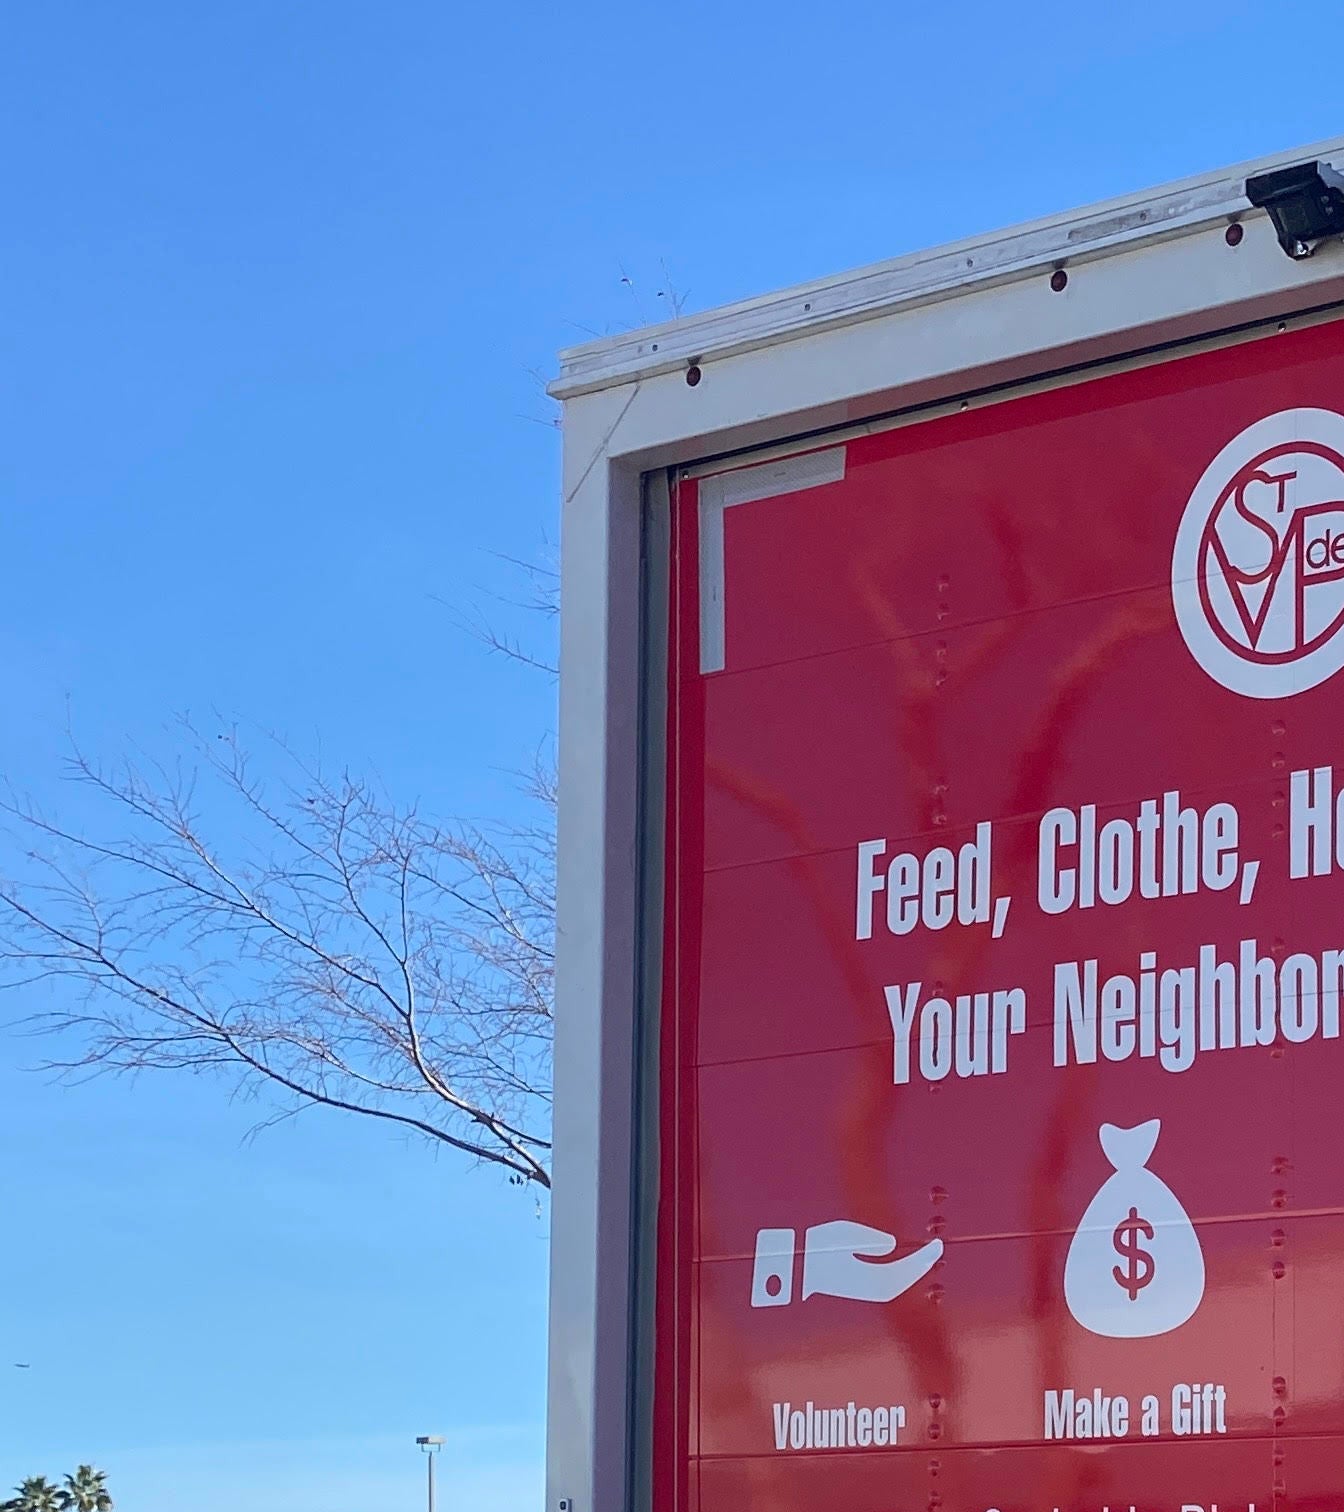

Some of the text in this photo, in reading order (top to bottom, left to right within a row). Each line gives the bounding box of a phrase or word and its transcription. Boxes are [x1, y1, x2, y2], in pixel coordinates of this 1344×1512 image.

[856, 822, 1011, 940] Feed,
[1038, 791, 1260, 905] Clothe,
[884, 982, 1025, 1084] Your
[773, 1402, 905, 1449] Volunteer
[1045, 1383, 1226, 1439] Make a Gift
